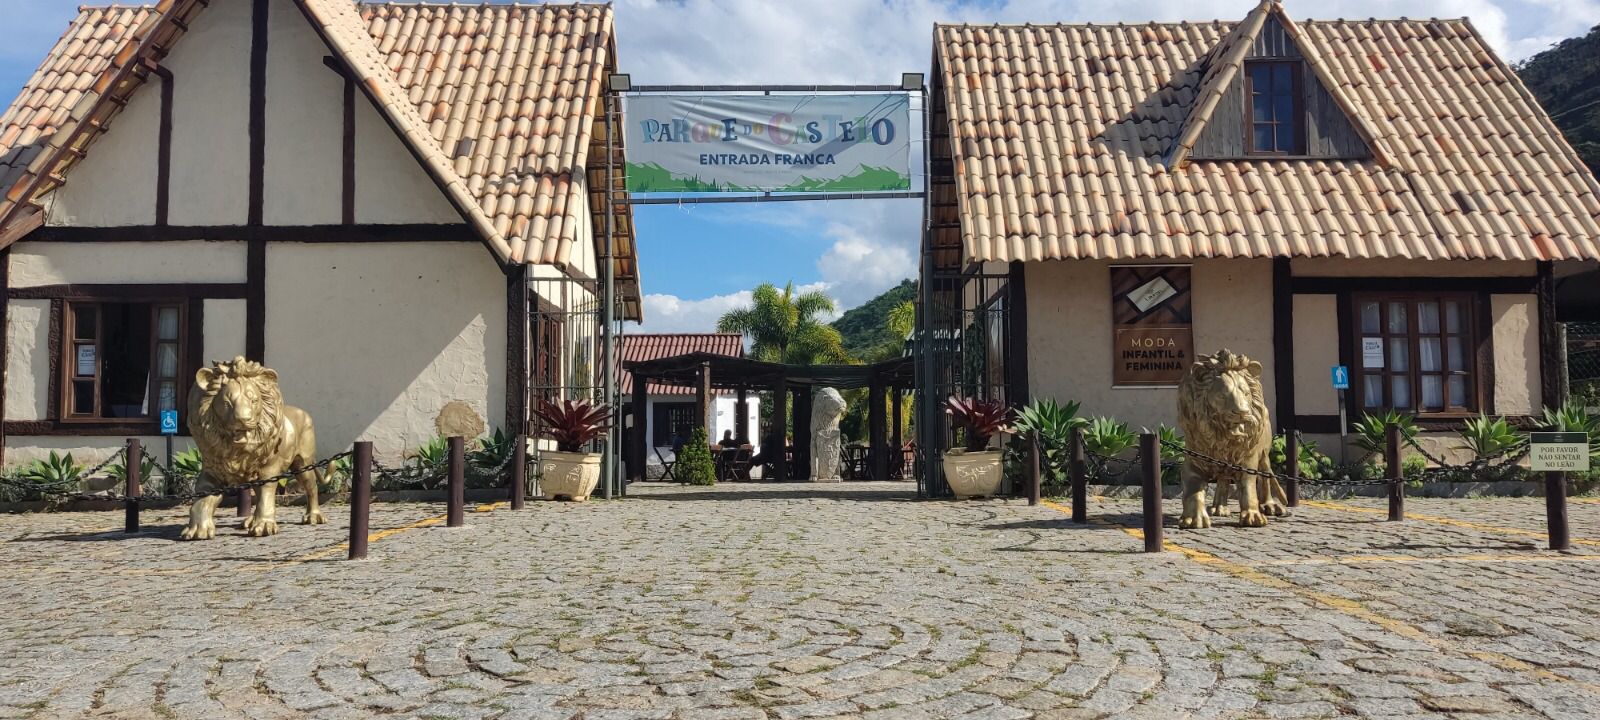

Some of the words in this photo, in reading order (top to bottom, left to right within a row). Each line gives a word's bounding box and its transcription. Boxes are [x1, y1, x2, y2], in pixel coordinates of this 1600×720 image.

[640, 118, 738, 143] PARQUE
[743, 123, 765, 136] DO
[767, 113, 896, 146] CASTELO
[699, 153, 770, 166] ENTRADA
[774, 153, 836, 166] FRANCA
[1131, 338, 1176, 347] MODA
[1122, 350, 1175, 359] INFANTIL
[1177, 350, 1185, 359] &
[1126, 361, 1182, 371] FEMININA
[1554, 453, 1581, 461] SENTAR
